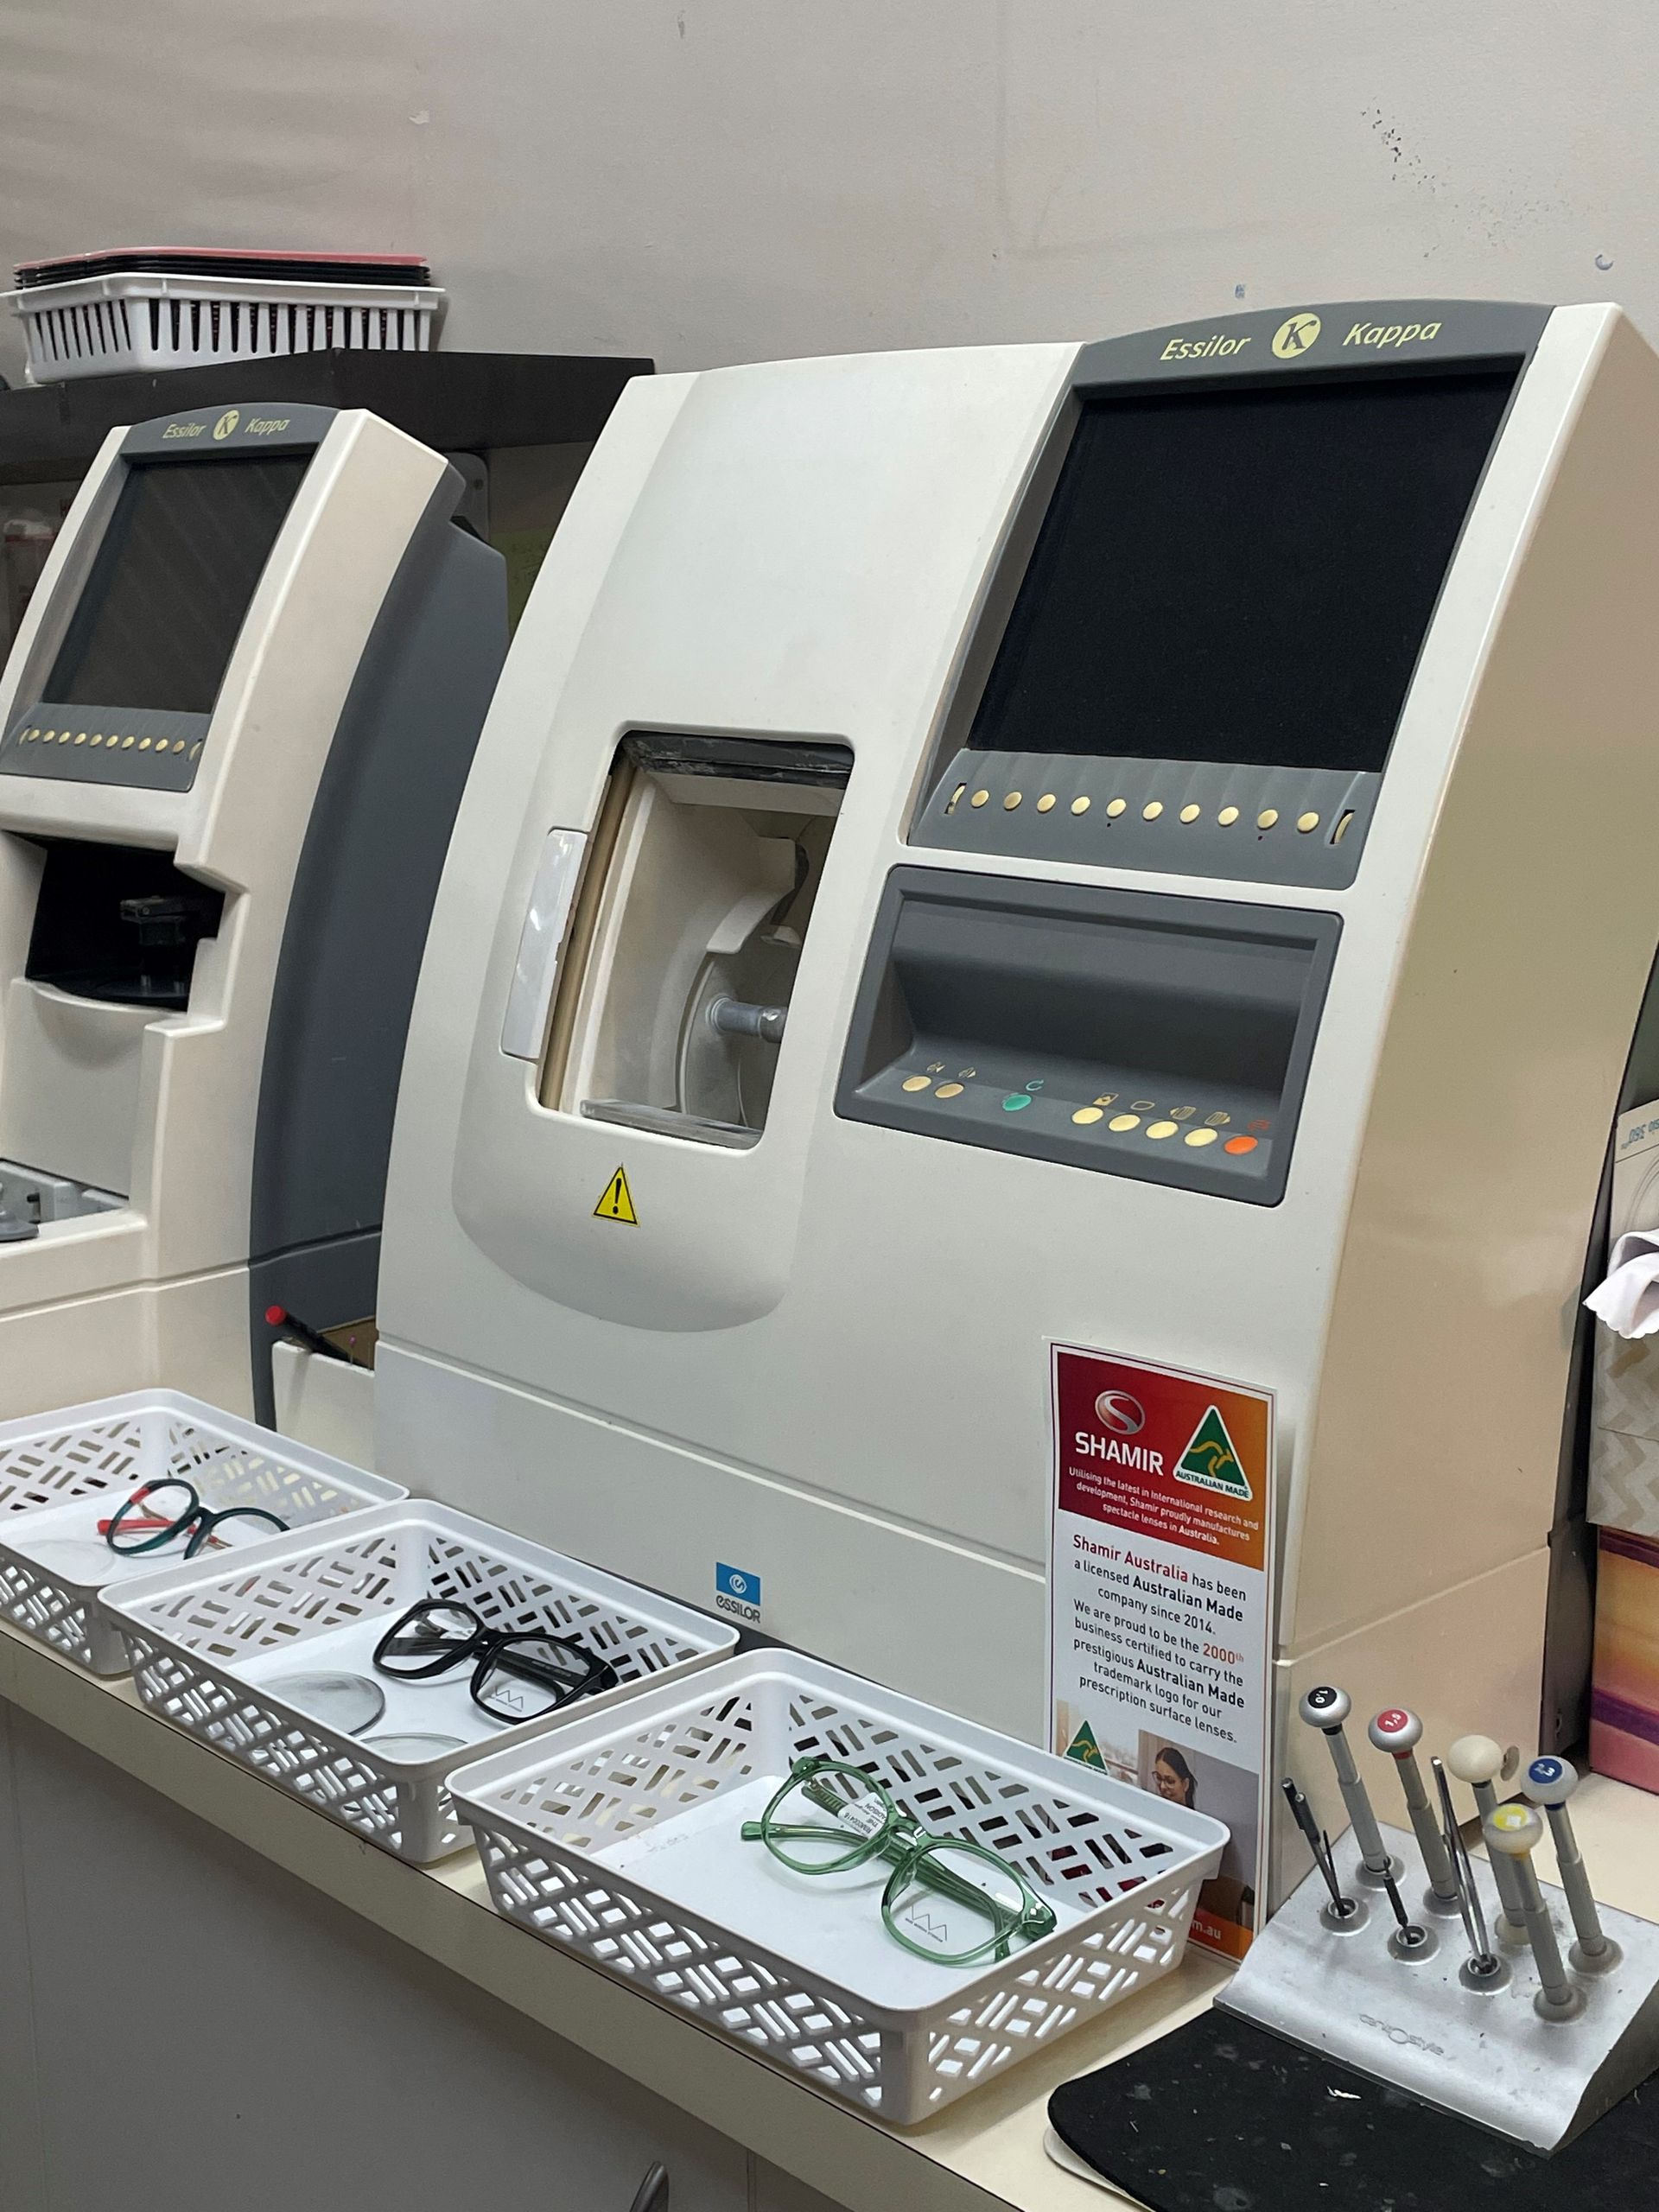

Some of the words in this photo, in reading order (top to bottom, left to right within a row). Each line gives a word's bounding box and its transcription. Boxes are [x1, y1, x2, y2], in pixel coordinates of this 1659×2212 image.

[1160, 334, 1251, 360] Essilor
[1343, 321, 1441, 348] Kappa
[162, 423, 207, 439] Essilor
[245, 417, 291, 436] Kappa
[1074, 1431, 1164, 1477] SHAMIR
[1069, 1466, 1103, 1485] Utilising
[1103, 1476, 1116, 1488] the
[1117, 1479, 1141, 1496] latest
[1141, 1487, 1150, 1497] in
[1205, 1507, 1242, 1525] research
[1243, 1518, 1259, 1531] and
[1076, 1481, 1128, 1506] development,
[1129, 1497, 1160, 1513] Shamir
[1160, 1507, 1192, 1525] proudly
[1192, 1516, 1250, 1541] manufactures
[1175, 1470, 1224, 1491] AUSTRALIAN
[1224, 1484, 1250, 1499] MADE
[1103, 1503, 1140, 1522] spectacle
[1141, 1513, 1168, 1530] lenses
[1169, 1521, 1178, 1532] in
[1179, 1524, 1220, 1546] Australia.
[1072, 1534, 1122, 1561] Shamir
[1124, 1550, 1188, 1583] Australia
[1192, 1573, 1213, 1591] has
[1216, 1580, 1246, 1601] been
[1074, 1560, 1081, 1569] a
[1084, 1559, 1129, 1586] licensed
[1133, 1574, 1202, 1609] Australian
[1206, 1597, 1243, 1622] Made
[1073, 1598, 1091, 1615] We
[1093, 1608, 1111, 1622] are
[1114, 1616, 1147, 1636] proud
[1148, 1625, 1160, 1640] to
[1163, 1630, 1177, 1646] be
[1180, 1636, 1199, 1653] the
[1203, 1643, 1244, 1665] 2000th
[1097, 1587, 1148, 1615] company
[1150, 1604, 1181, 1623] since
[1184, 1613, 1216, 1635] 2014.
[1073, 1638, 1135, 1669] prestigious
[1136, 1658, 1205, 1694] Australian
[1208, 1683, 1245, 1708] Made
[1075, 1616, 1123, 1644] business
[1125, 1637, 1172, 1662] certified
[1174, 1653, 1186, 1667] to
[1189, 1661, 1221, 1681] carry
[1224, 1669, 1243, 1688] the
[1079, 1675, 1147, 1709] prescription
[1149, 1701, 1192, 1726] surface
[1194, 1716, 1237, 1743] lenses.
[1093, 1661, 1153, 1694] trademark
[1154, 1683, 1179, 1703] logo
[1182, 1694, 1199, 1710] for
[1201, 1704, 1223, 1719] our
